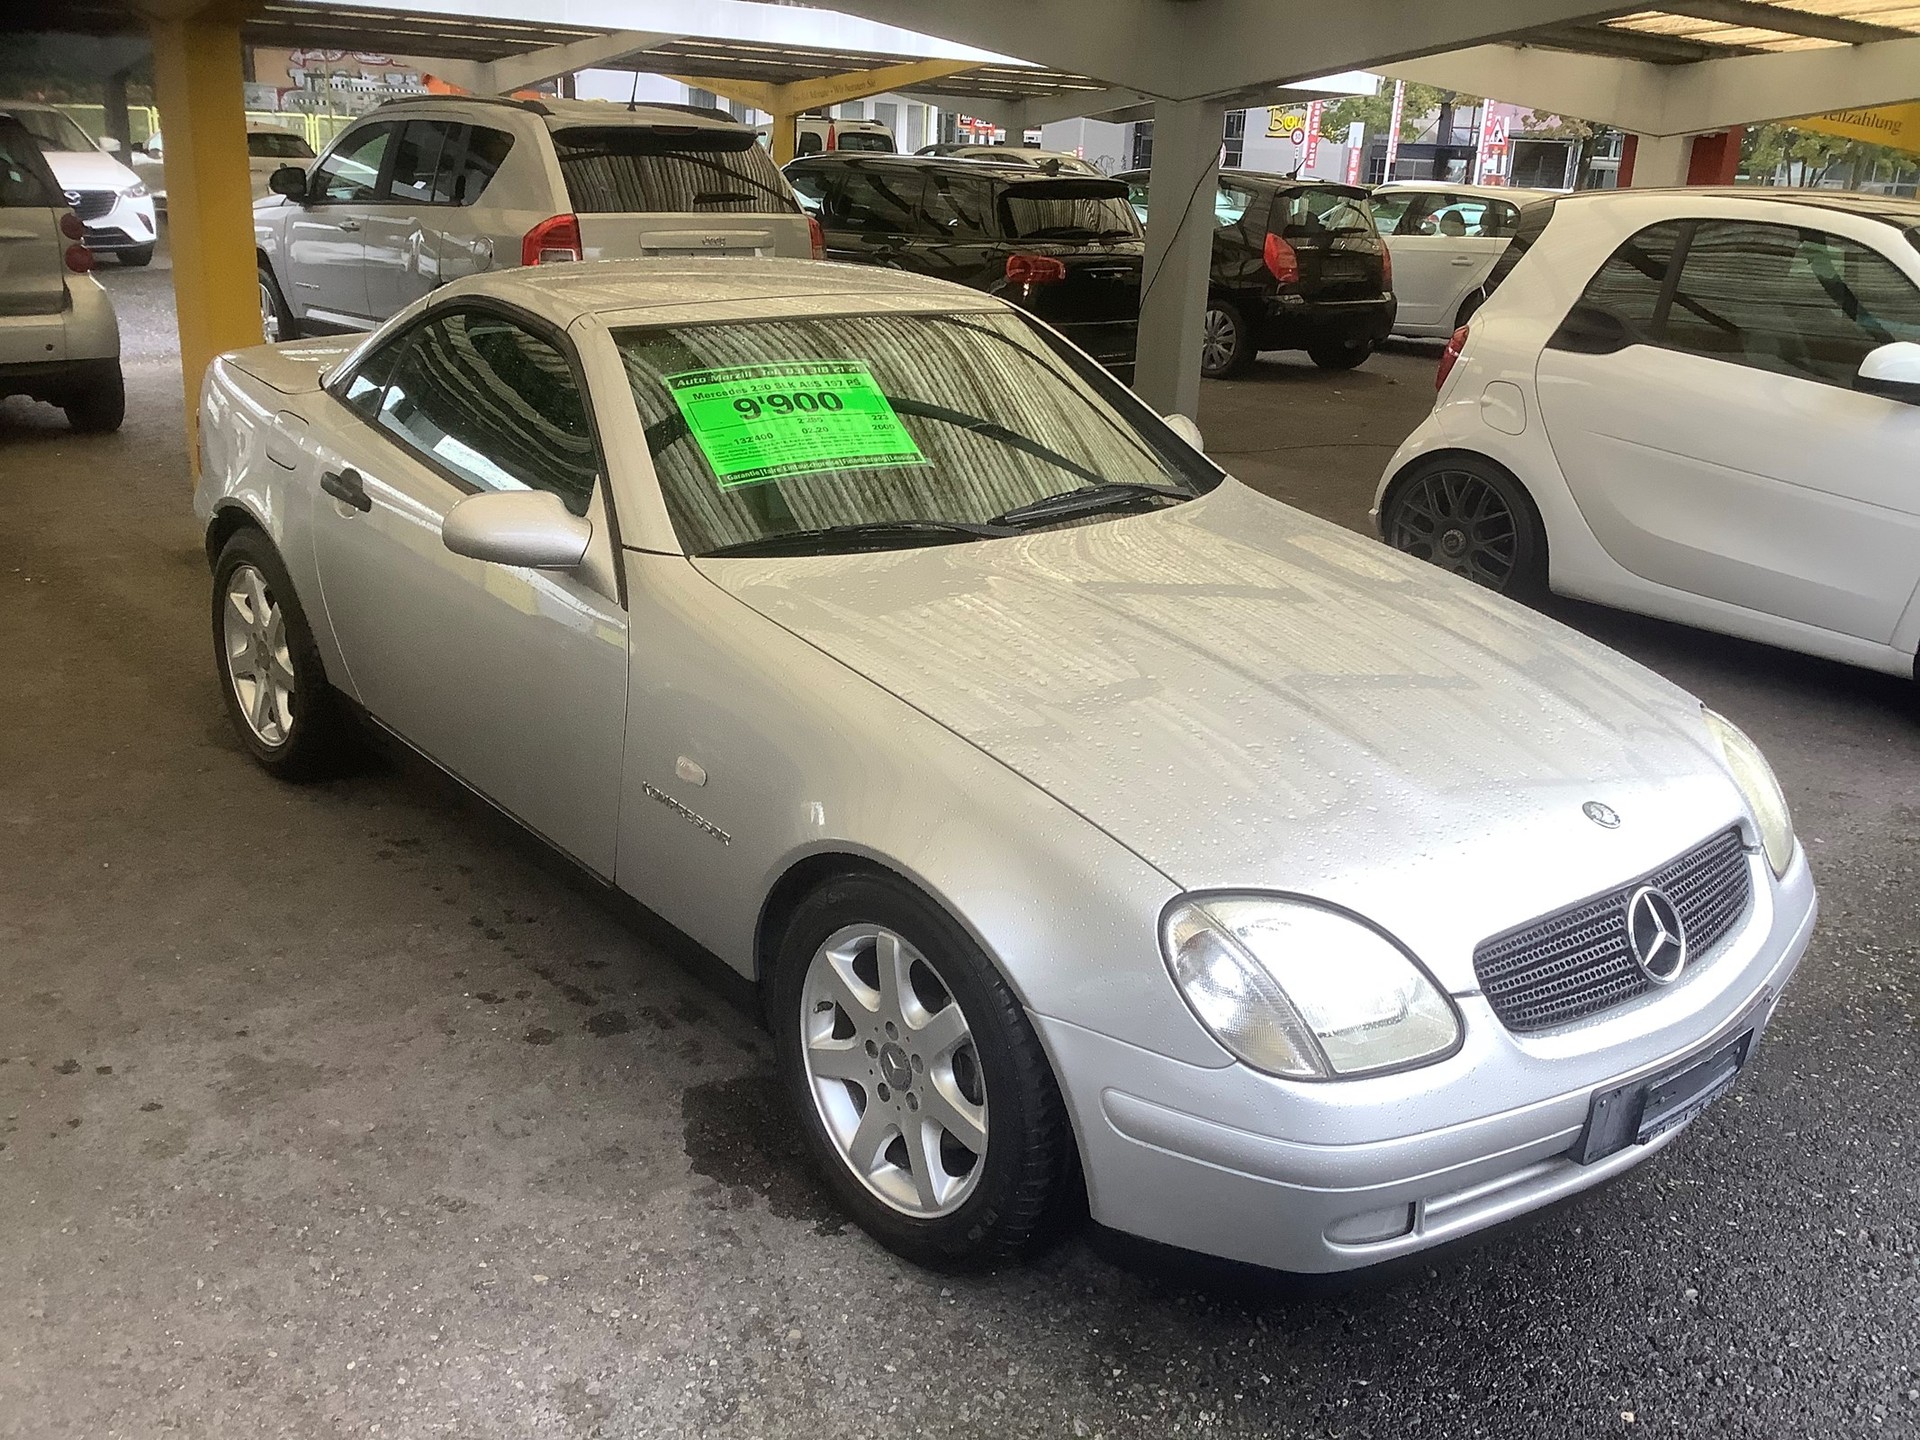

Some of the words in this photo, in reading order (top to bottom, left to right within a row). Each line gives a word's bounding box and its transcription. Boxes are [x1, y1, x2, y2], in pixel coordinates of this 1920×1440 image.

[1310, 101, 1322, 136] Ankau
[1306, 142, 1317, 166] Auto
[677, 376, 706, 387] Auto
[711, 371, 752, 382] Marzili
[786, 367, 805, 375] 031
[693, 388, 748, 400] Mercedes
[750, 384, 771, 392] 230
[774, 381, 796, 389] SLK
[800, 380, 822, 388] ABS
[847, 378, 861, 386] PS
[733, 391, 843, 420] 9'900
